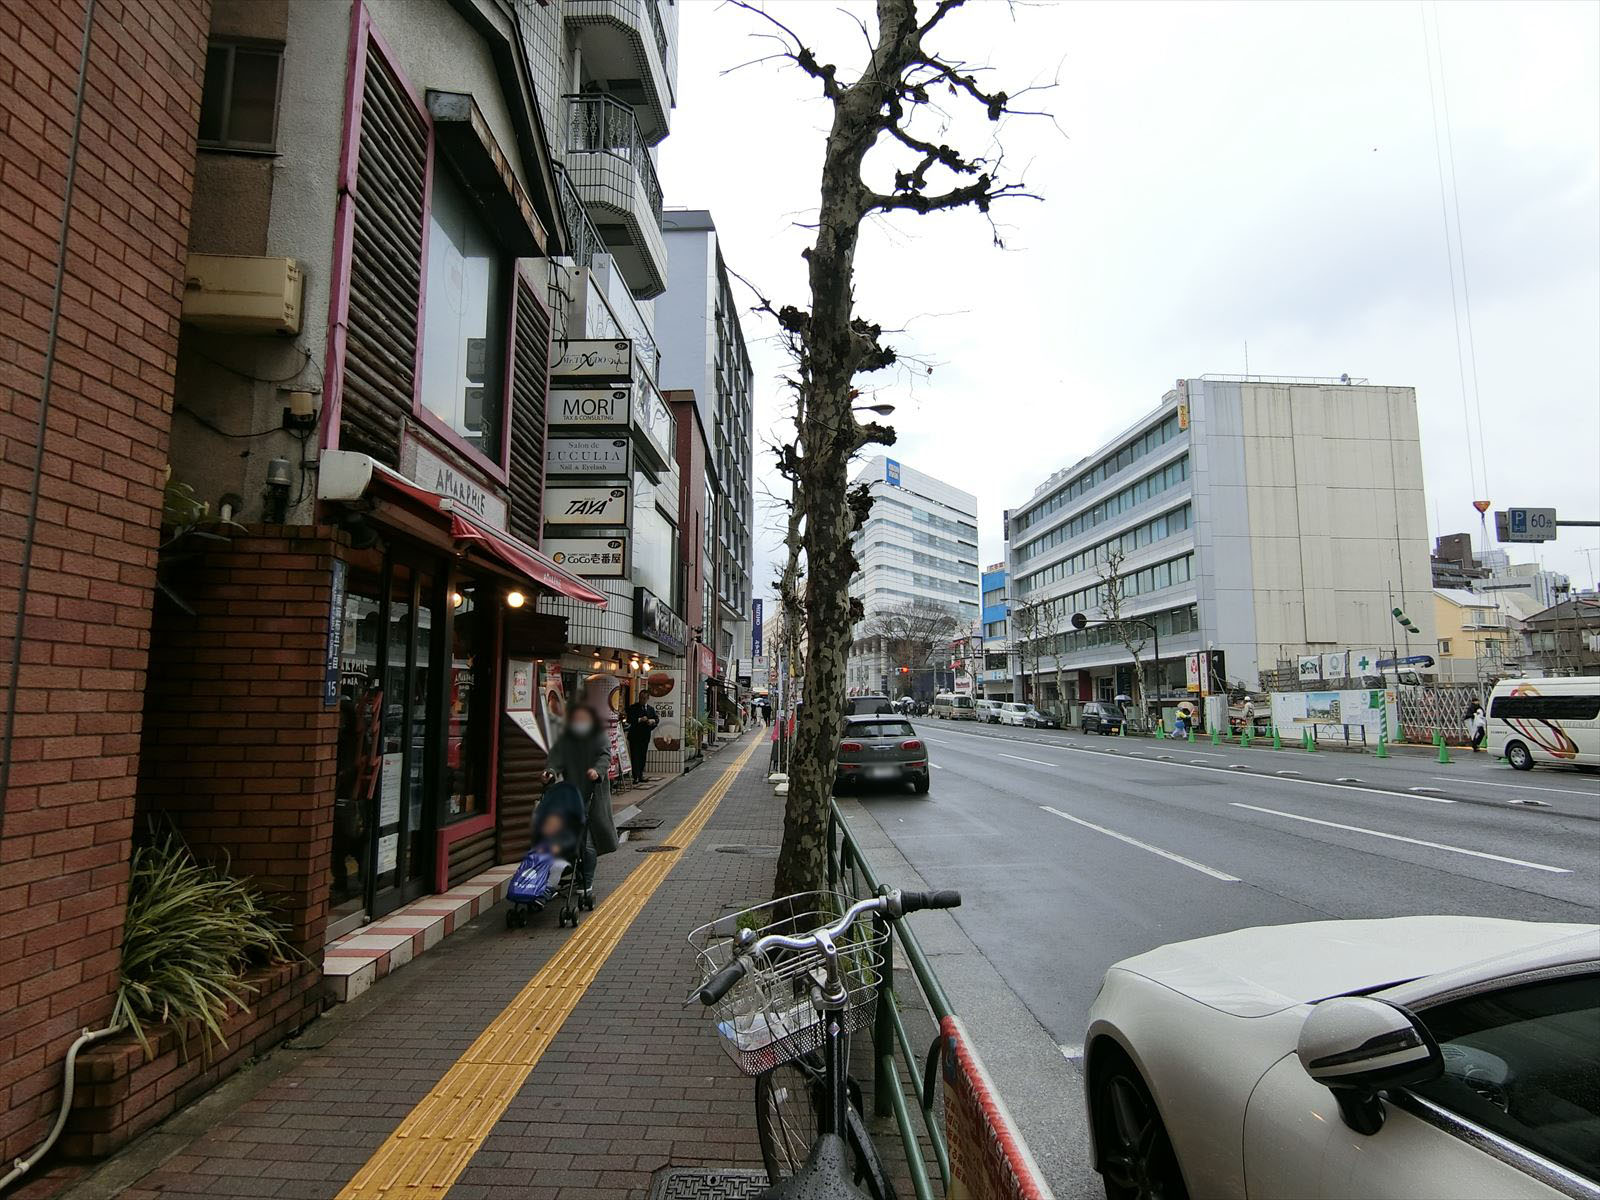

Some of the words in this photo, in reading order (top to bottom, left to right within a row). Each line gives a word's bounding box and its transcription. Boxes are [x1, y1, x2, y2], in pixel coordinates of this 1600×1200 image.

[563, 399, 614, 415] MORI
[569, 441, 589, 449] Salon
[591, 441, 599, 449] de
[547, 451, 620, 461] LUCULIA
[565, 501, 608, 514] TAYA
[1516, 512, 1523, 524] P
[328, 681, 336, 696] 15
